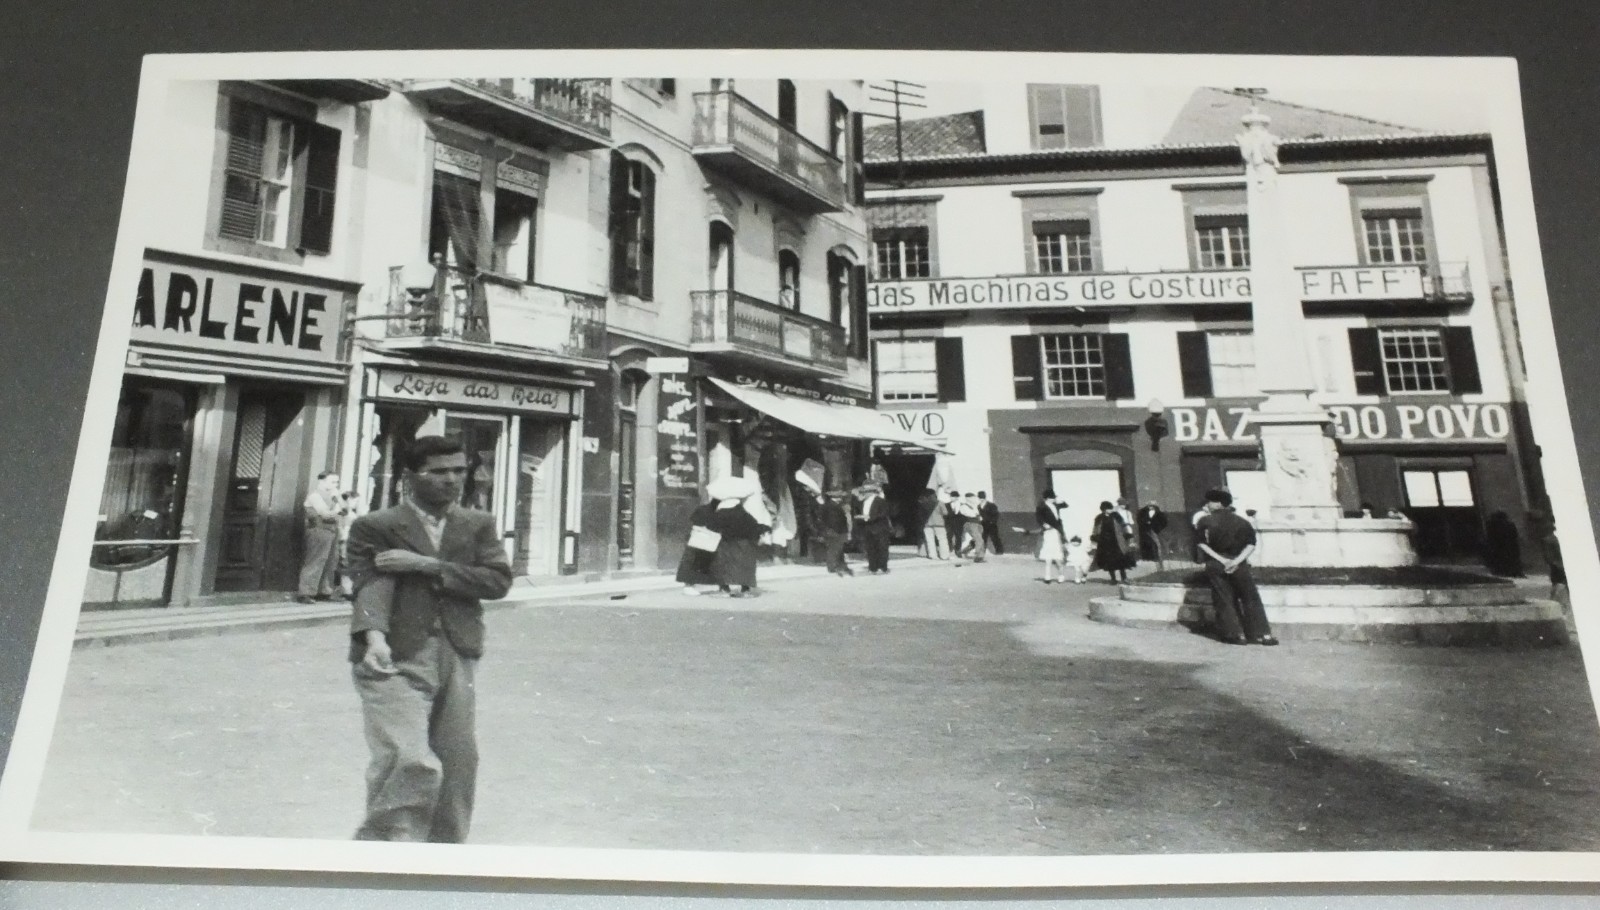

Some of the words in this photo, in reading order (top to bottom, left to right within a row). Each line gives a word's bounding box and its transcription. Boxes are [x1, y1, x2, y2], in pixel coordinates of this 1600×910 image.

[868, 285, 915, 307] das
[929, 278, 1069, 306] Machinas
[1081, 276, 1116, 300] de
[1128, 275, 1252, 300] Costura
[132, 267, 328, 351] ARLENE
[394, 375, 449, 395] Loja
[463, 380, 499, 400] das
[736, 375, 768, 388] CASA
[1171, 407, 1257, 441] BAZ
[1396, 404, 1510, 439] POVO
